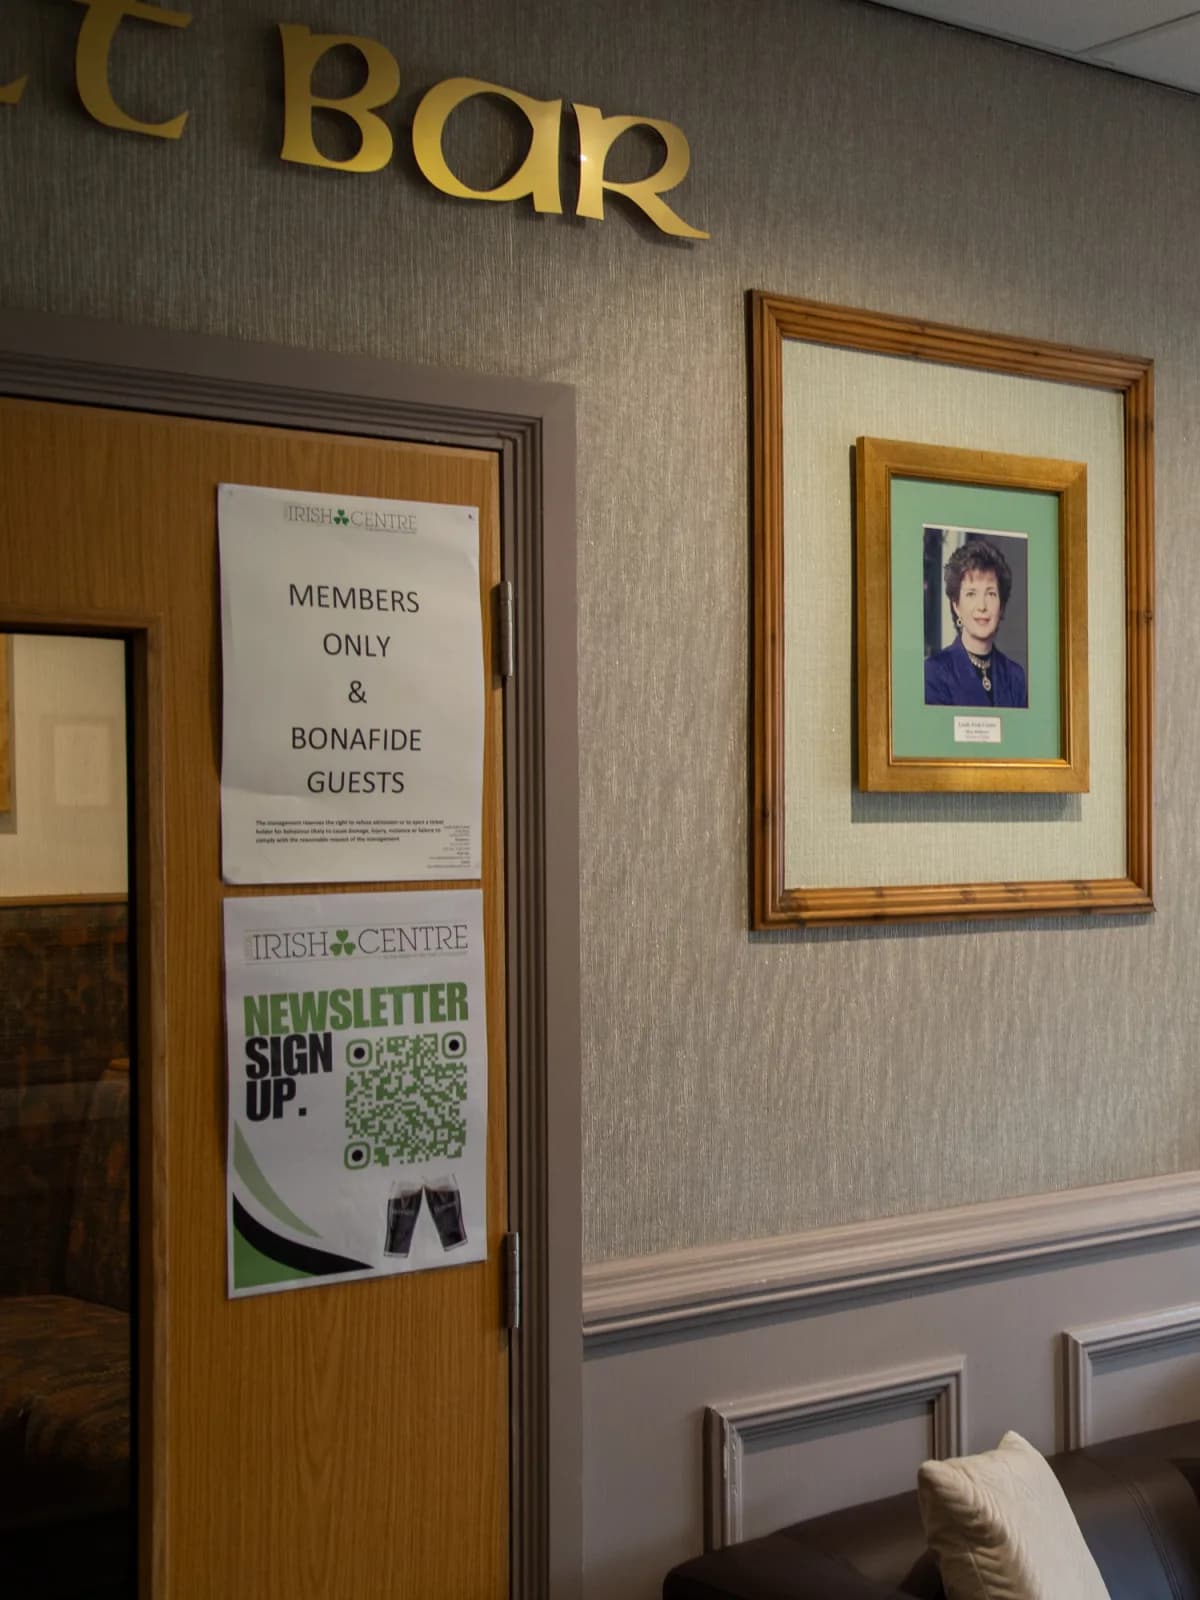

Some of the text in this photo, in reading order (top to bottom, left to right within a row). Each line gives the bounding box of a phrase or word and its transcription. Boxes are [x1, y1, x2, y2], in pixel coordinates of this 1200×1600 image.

[288, 505, 417, 531] IRISH CENTRE
[288, 583, 420, 613] MEMBERS
[322, 632, 391, 658] ONLY
[347, 680, 368, 704] &
[291, 726, 422, 752] BONAFIDE
[306, 771, 405, 794] GUESTS
[253, 931, 329, 960] IRISH
[358, 924, 468, 954] CENTRE
[243, 982, 469, 1037] NEWSLETTER
[245, 1032, 333, 1080] SIGN
[246, 1077, 307, 1122] UP.
